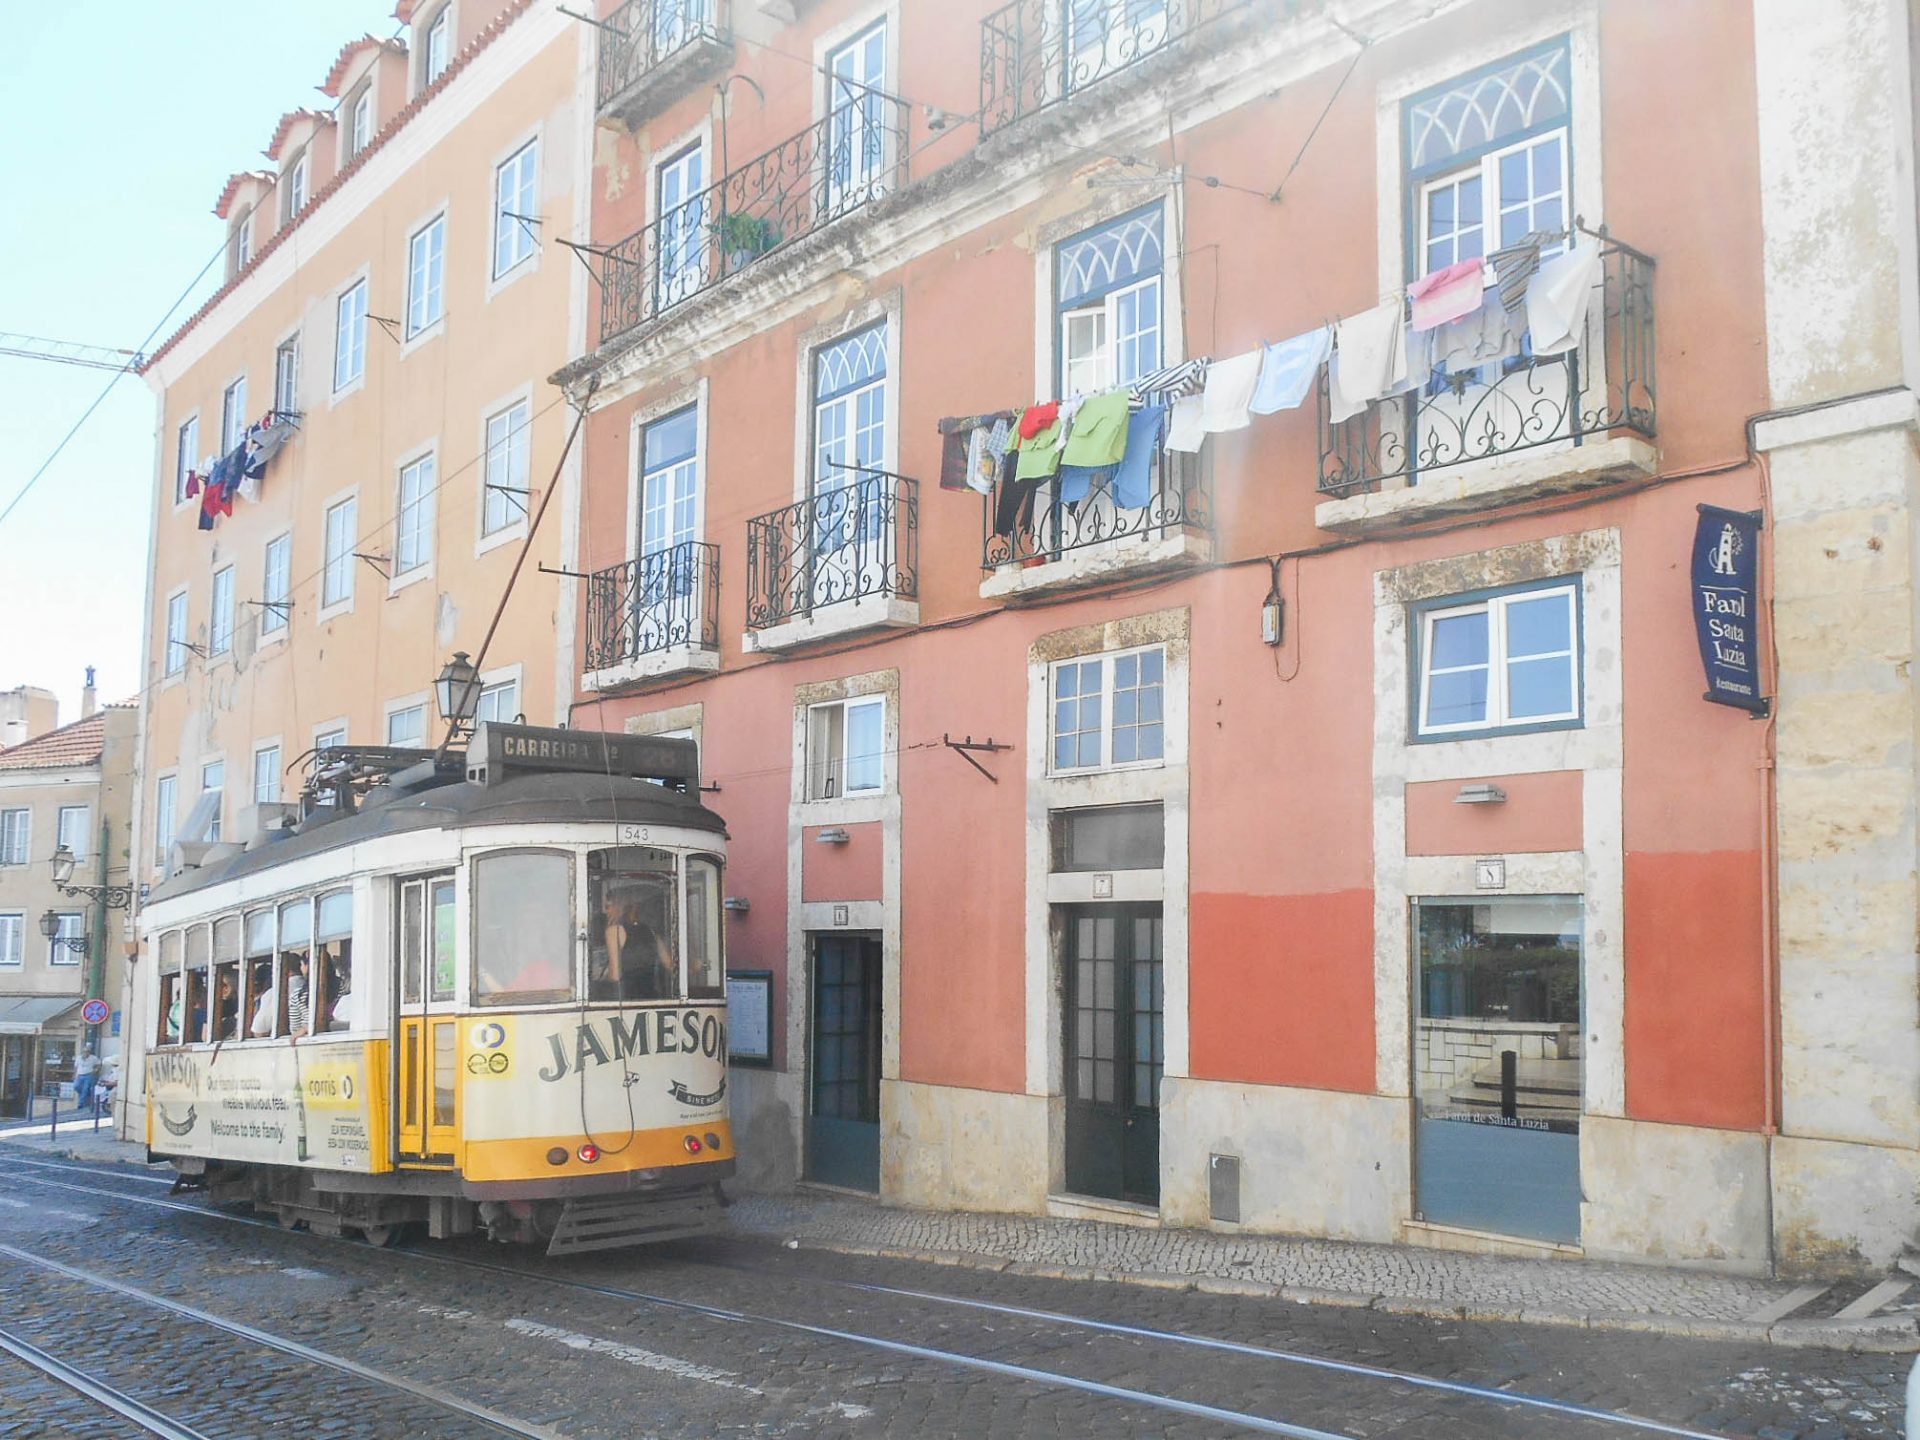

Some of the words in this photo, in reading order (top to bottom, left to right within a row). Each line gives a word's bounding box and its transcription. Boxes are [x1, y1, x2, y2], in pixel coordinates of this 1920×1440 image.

[624, 827, 649, 841] 543
[538, 1009, 727, 1083] JAMESON
[1473, 1110, 1485, 1123] de
[1488, 1112, 1517, 1127] Santa
[1520, 1115, 1549, 1130] Luzia
